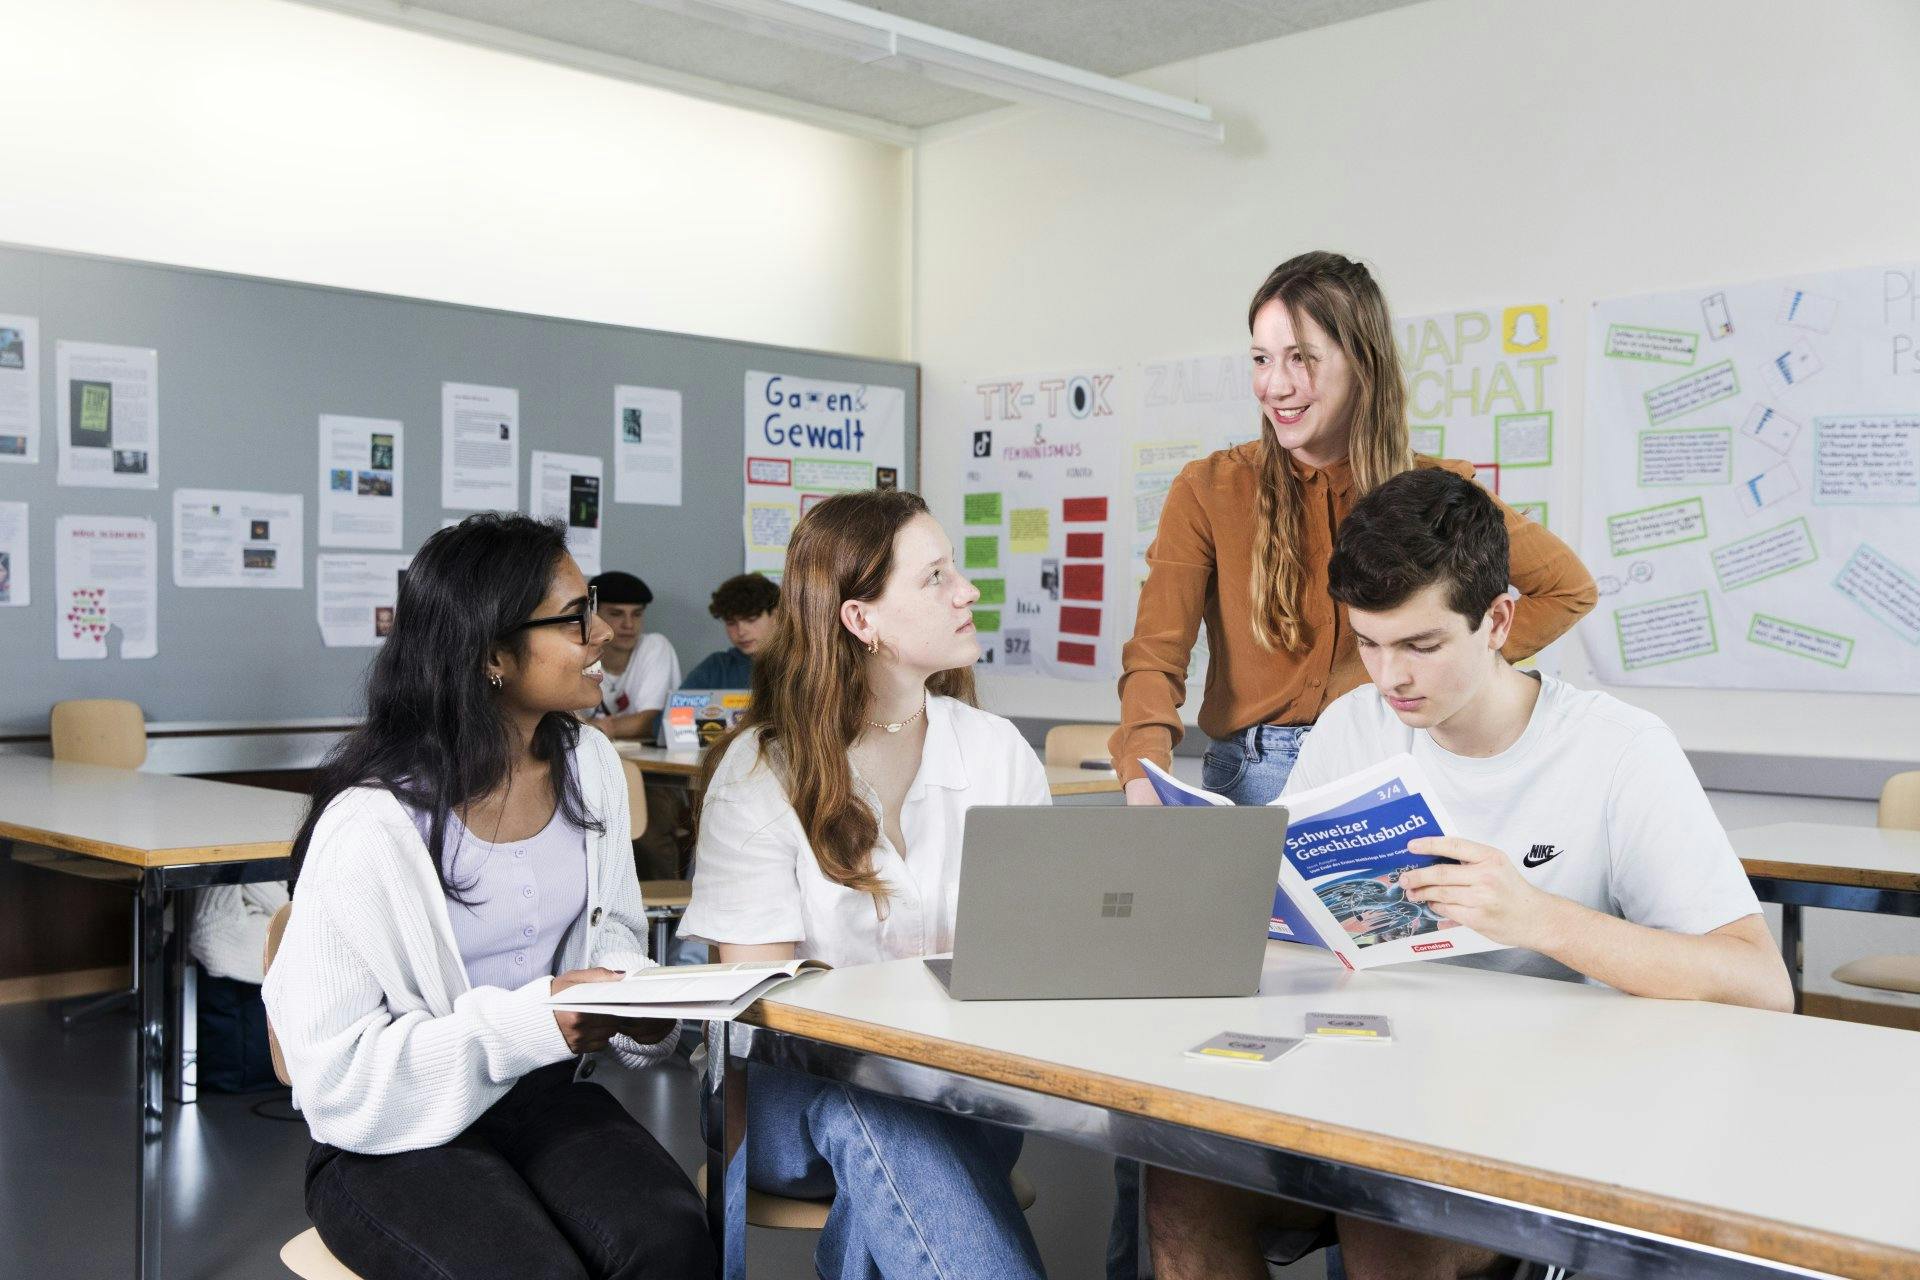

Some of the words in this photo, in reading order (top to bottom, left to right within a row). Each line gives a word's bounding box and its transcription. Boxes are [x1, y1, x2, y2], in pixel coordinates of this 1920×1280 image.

[1409, 356, 1557, 420] CHAT
[764, 413, 864, 452] Gewalt
[1376, 784, 1401, 800] 3/4
[1286, 818, 1368, 850] Schweizer
[1295, 814, 1428, 861] Geschichtsbuch
[1529, 844, 1555, 859] NIKE
[1414, 941, 1452, 953] Cornelsen
